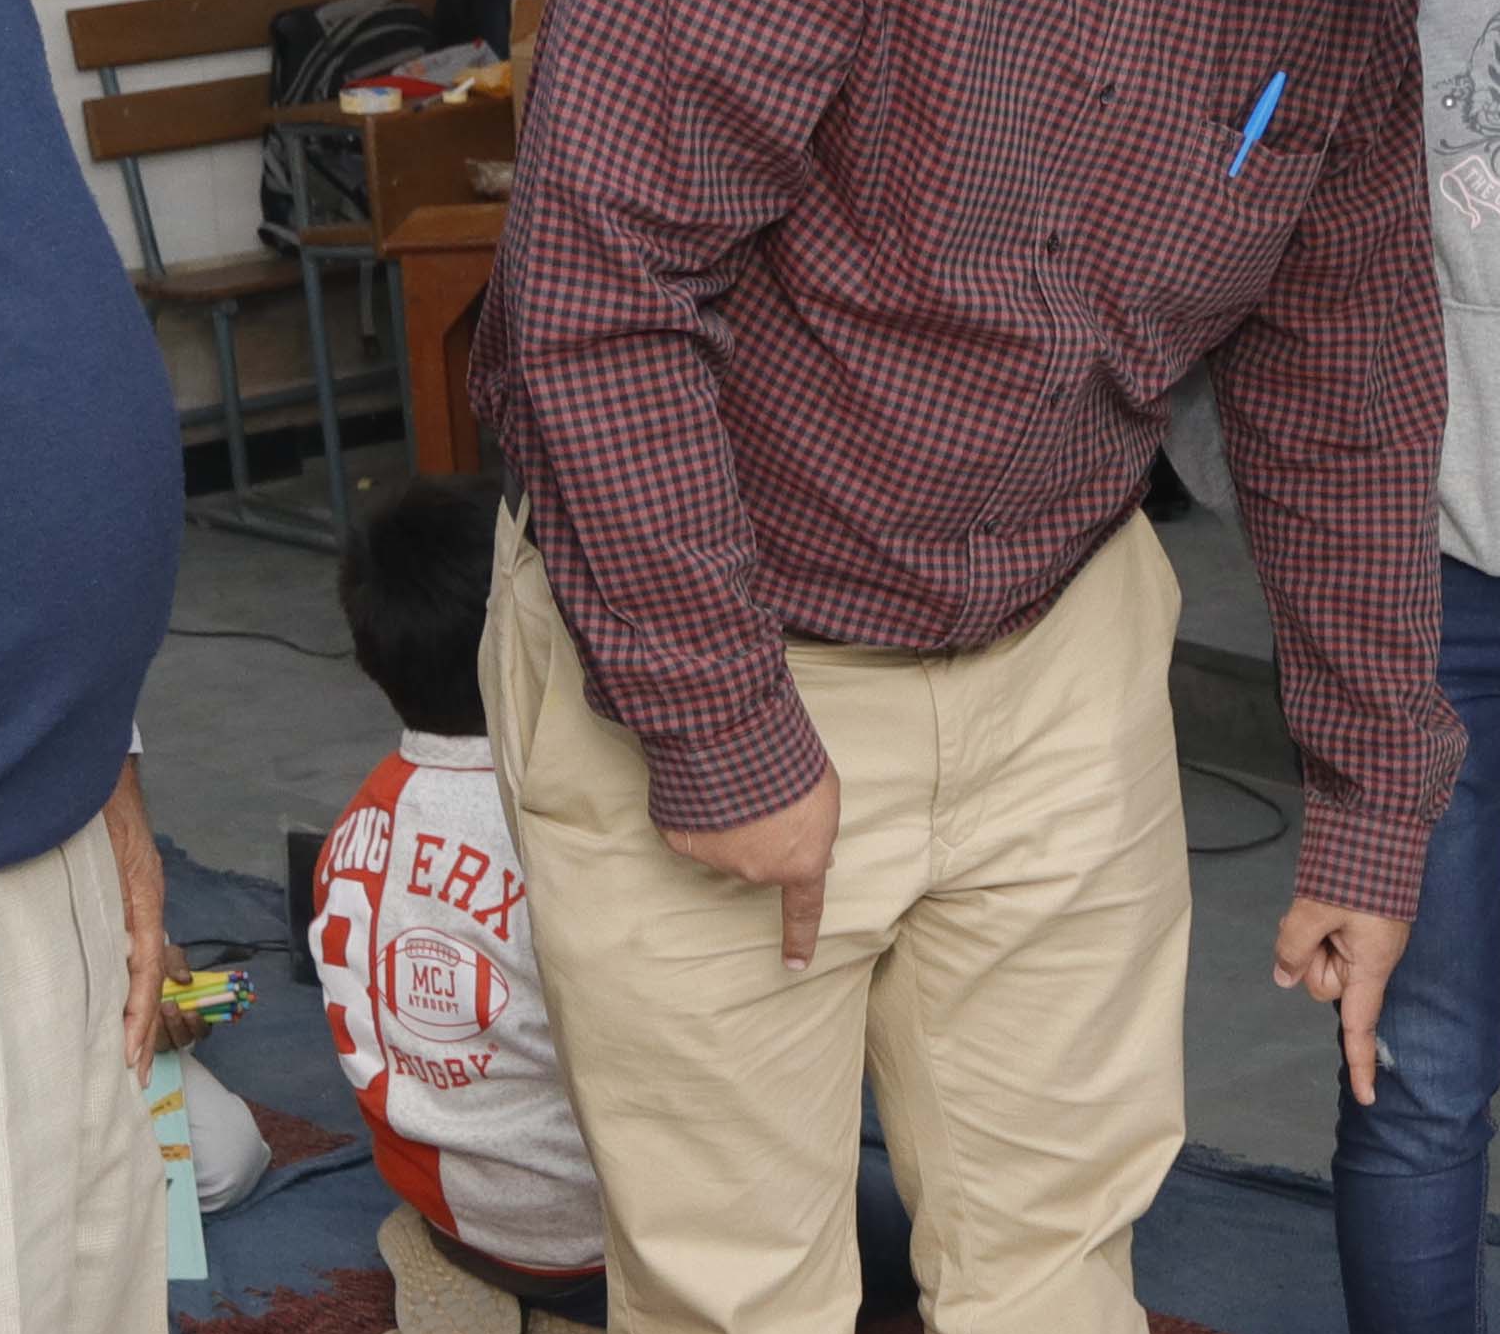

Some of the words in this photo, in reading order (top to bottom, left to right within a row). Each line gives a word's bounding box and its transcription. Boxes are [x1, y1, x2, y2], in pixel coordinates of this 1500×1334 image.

[1462, 166, 1492, 201] THE
[307, 875, 389, 1091] 8
[412, 962, 456, 998] MCJ
